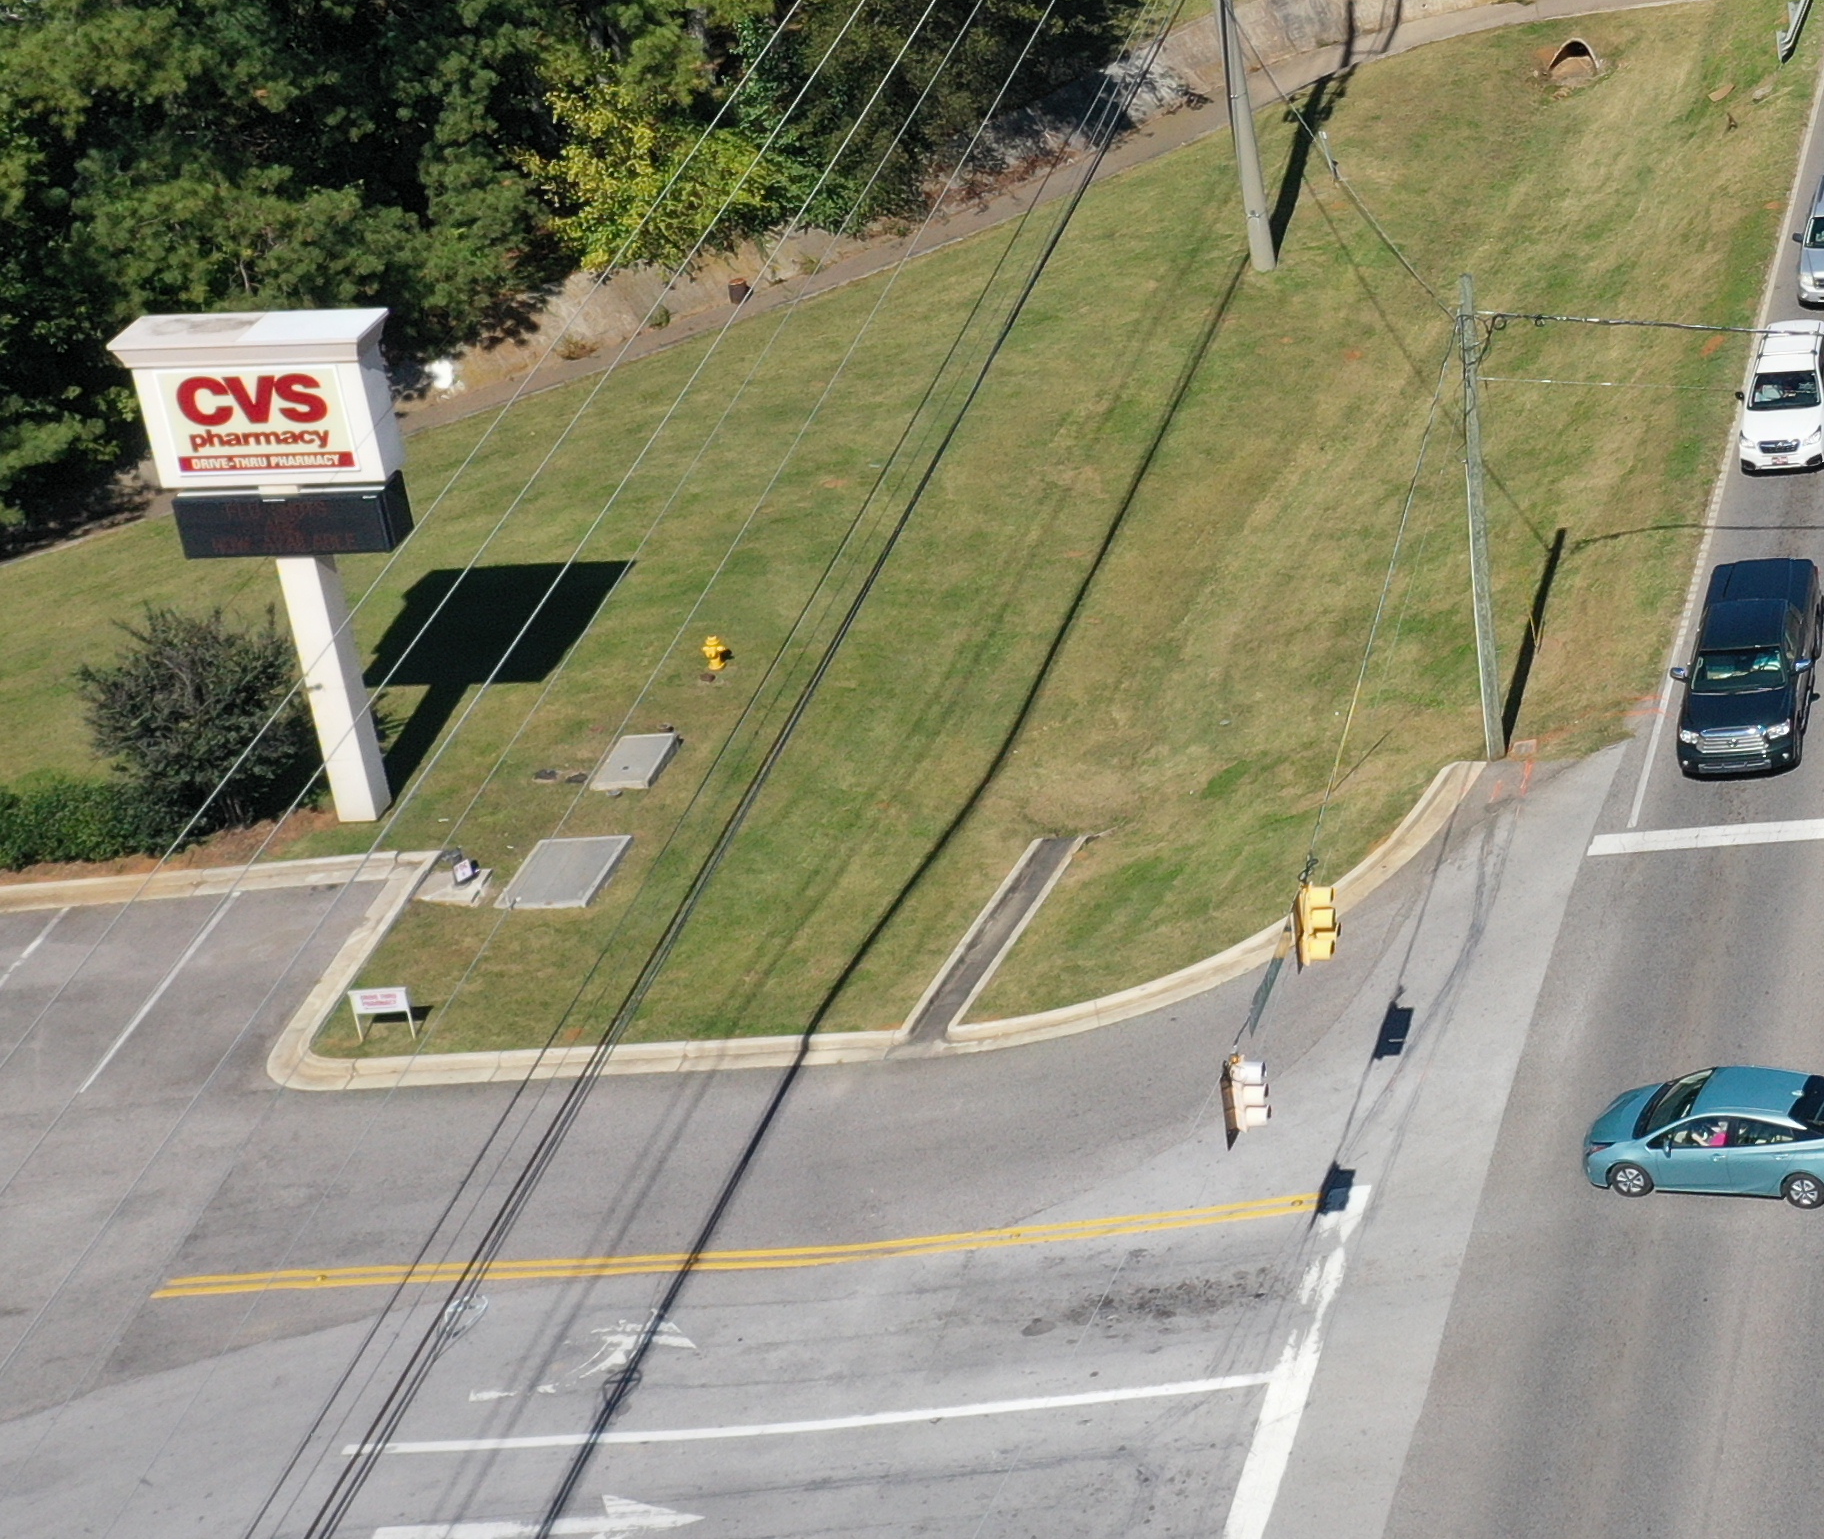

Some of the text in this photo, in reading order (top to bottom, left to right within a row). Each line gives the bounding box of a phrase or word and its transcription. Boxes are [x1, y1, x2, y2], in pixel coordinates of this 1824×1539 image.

[176, 373, 328, 426] CVS
[189, 428, 329, 453] pharmacy
[191, 454, 340, 471] DRIVE-THRU PHARMACY
